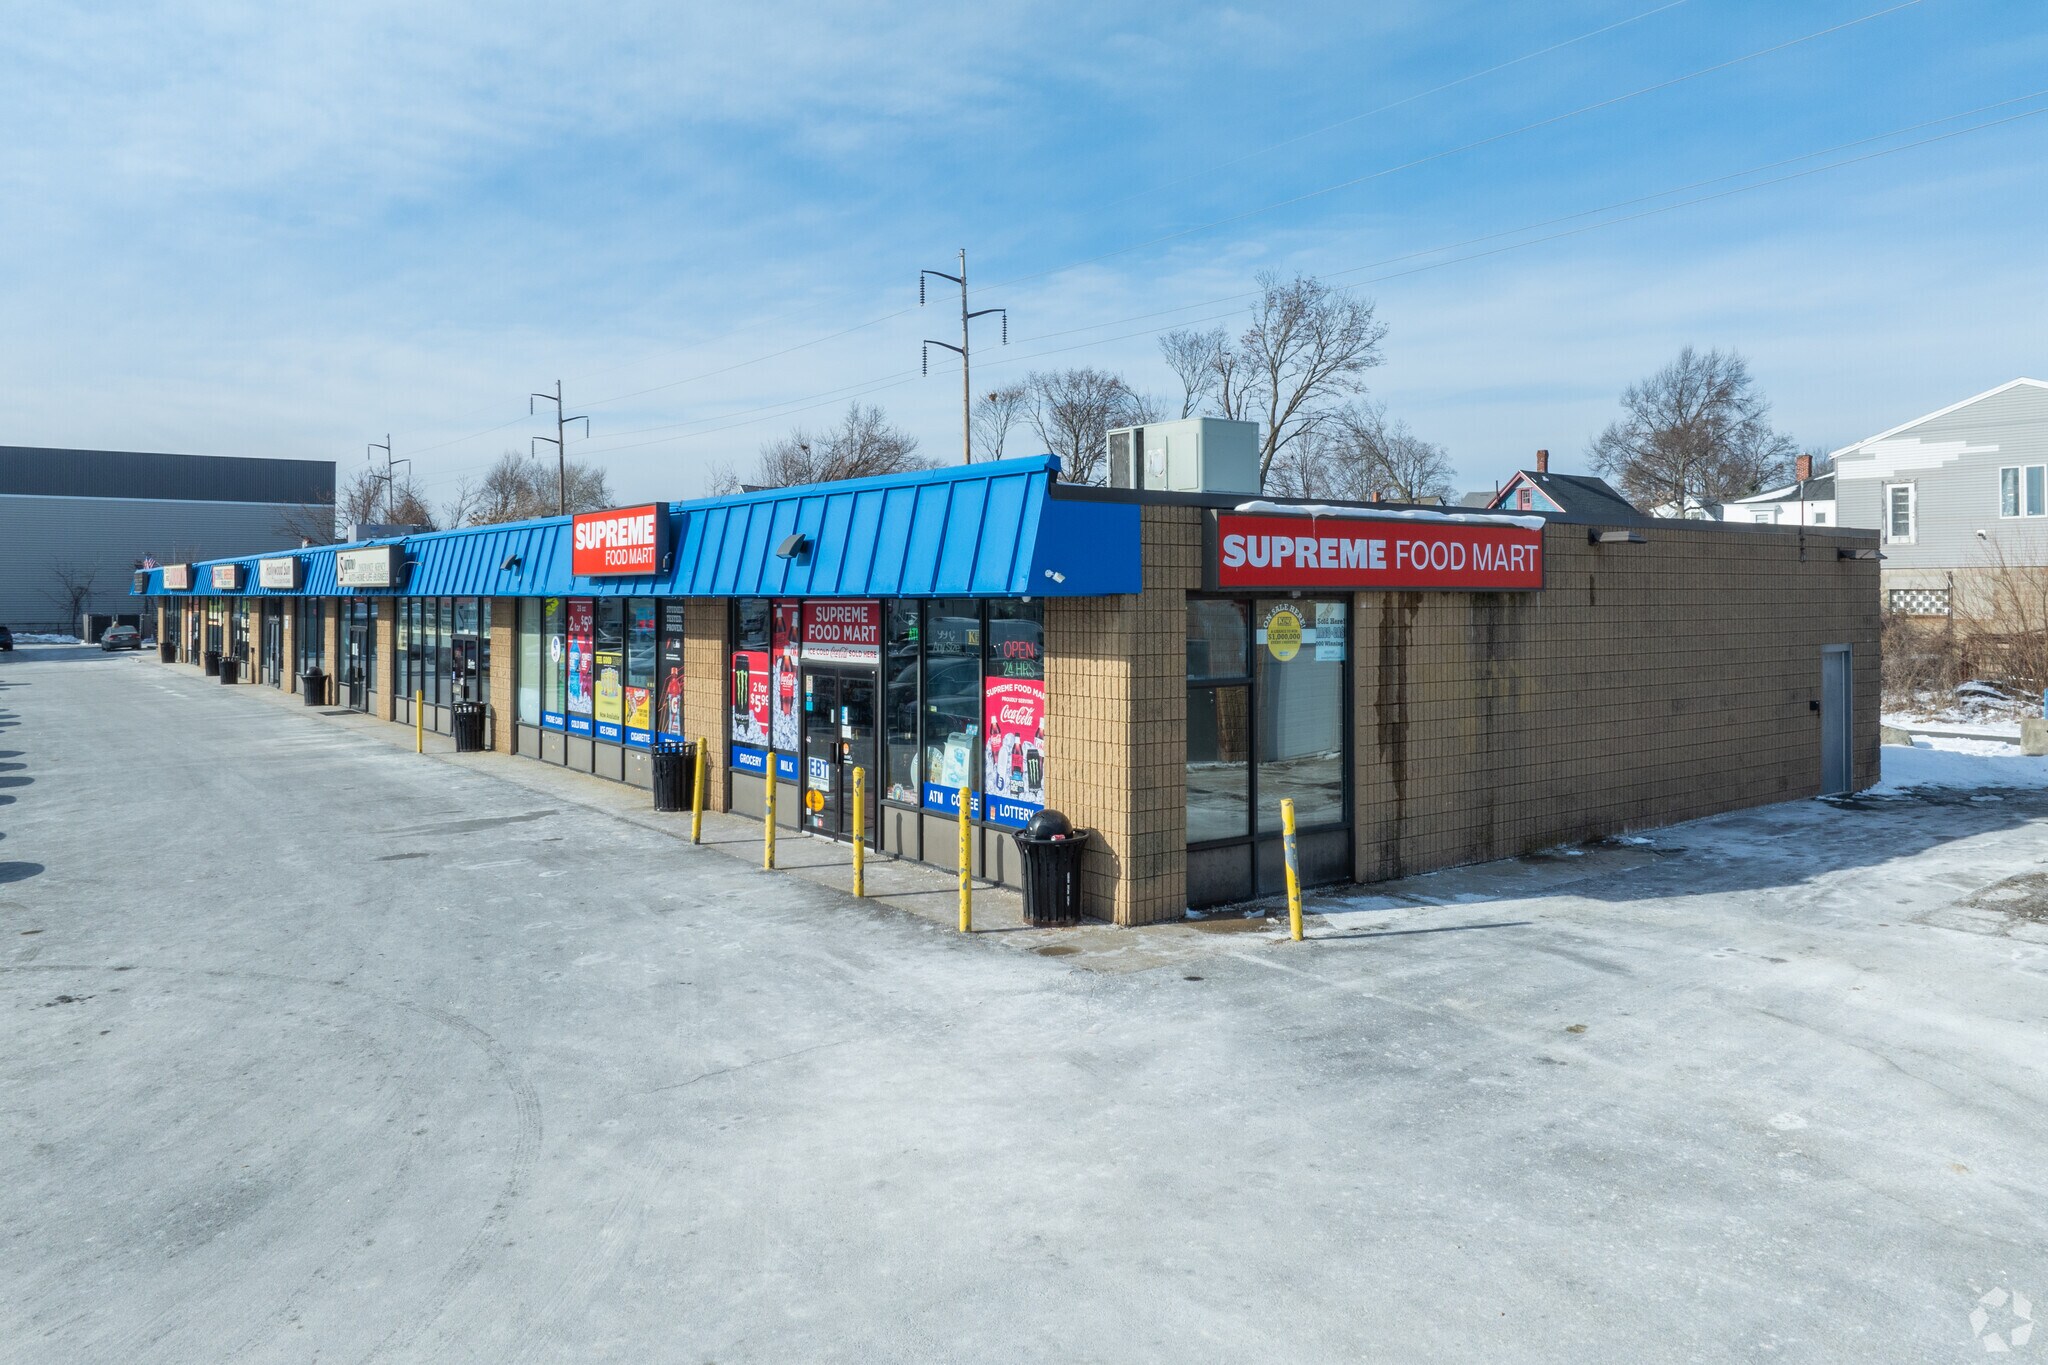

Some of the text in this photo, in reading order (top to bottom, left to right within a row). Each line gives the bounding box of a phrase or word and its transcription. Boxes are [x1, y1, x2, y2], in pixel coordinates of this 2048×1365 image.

[576, 514, 654, 550] SUPREME
[606, 546, 654, 566] FOOD MART
[1222, 534, 1538, 572] SUPREME FOOD MART
[816, 606, 868, 623] SUPREME
[1263, 604, 1306, 628] ON SALE HERE!
[569, 616, 574, 631] 2
[808, 624, 876, 642] FOOD MART
[864, 650, 877, 658] HERE
[1003, 641, 1034, 659] OPEN
[1003, 662, 1035, 678] 24 HRS
[753, 682, 767, 693] 2 for
[986, 684, 1013, 697] SUPREME
[1014, 684, 1032, 694] FOOD
[671, 697, 678, 713] G
[545, 714, 563, 725] PHONE CARD
[571, 720, 589, 730] COLD DRINK
[606, 726, 617, 737] CREAM
[631, 732, 650, 743] CIGARETTE
[740, 753, 794, 773] GROCERY MILK
[810, 759, 828, 778] EBT
[929, 790, 943, 804] ATM
[951, 793, 978, 811] COEE
[1000, 804, 1034, 821] LOTTERY
